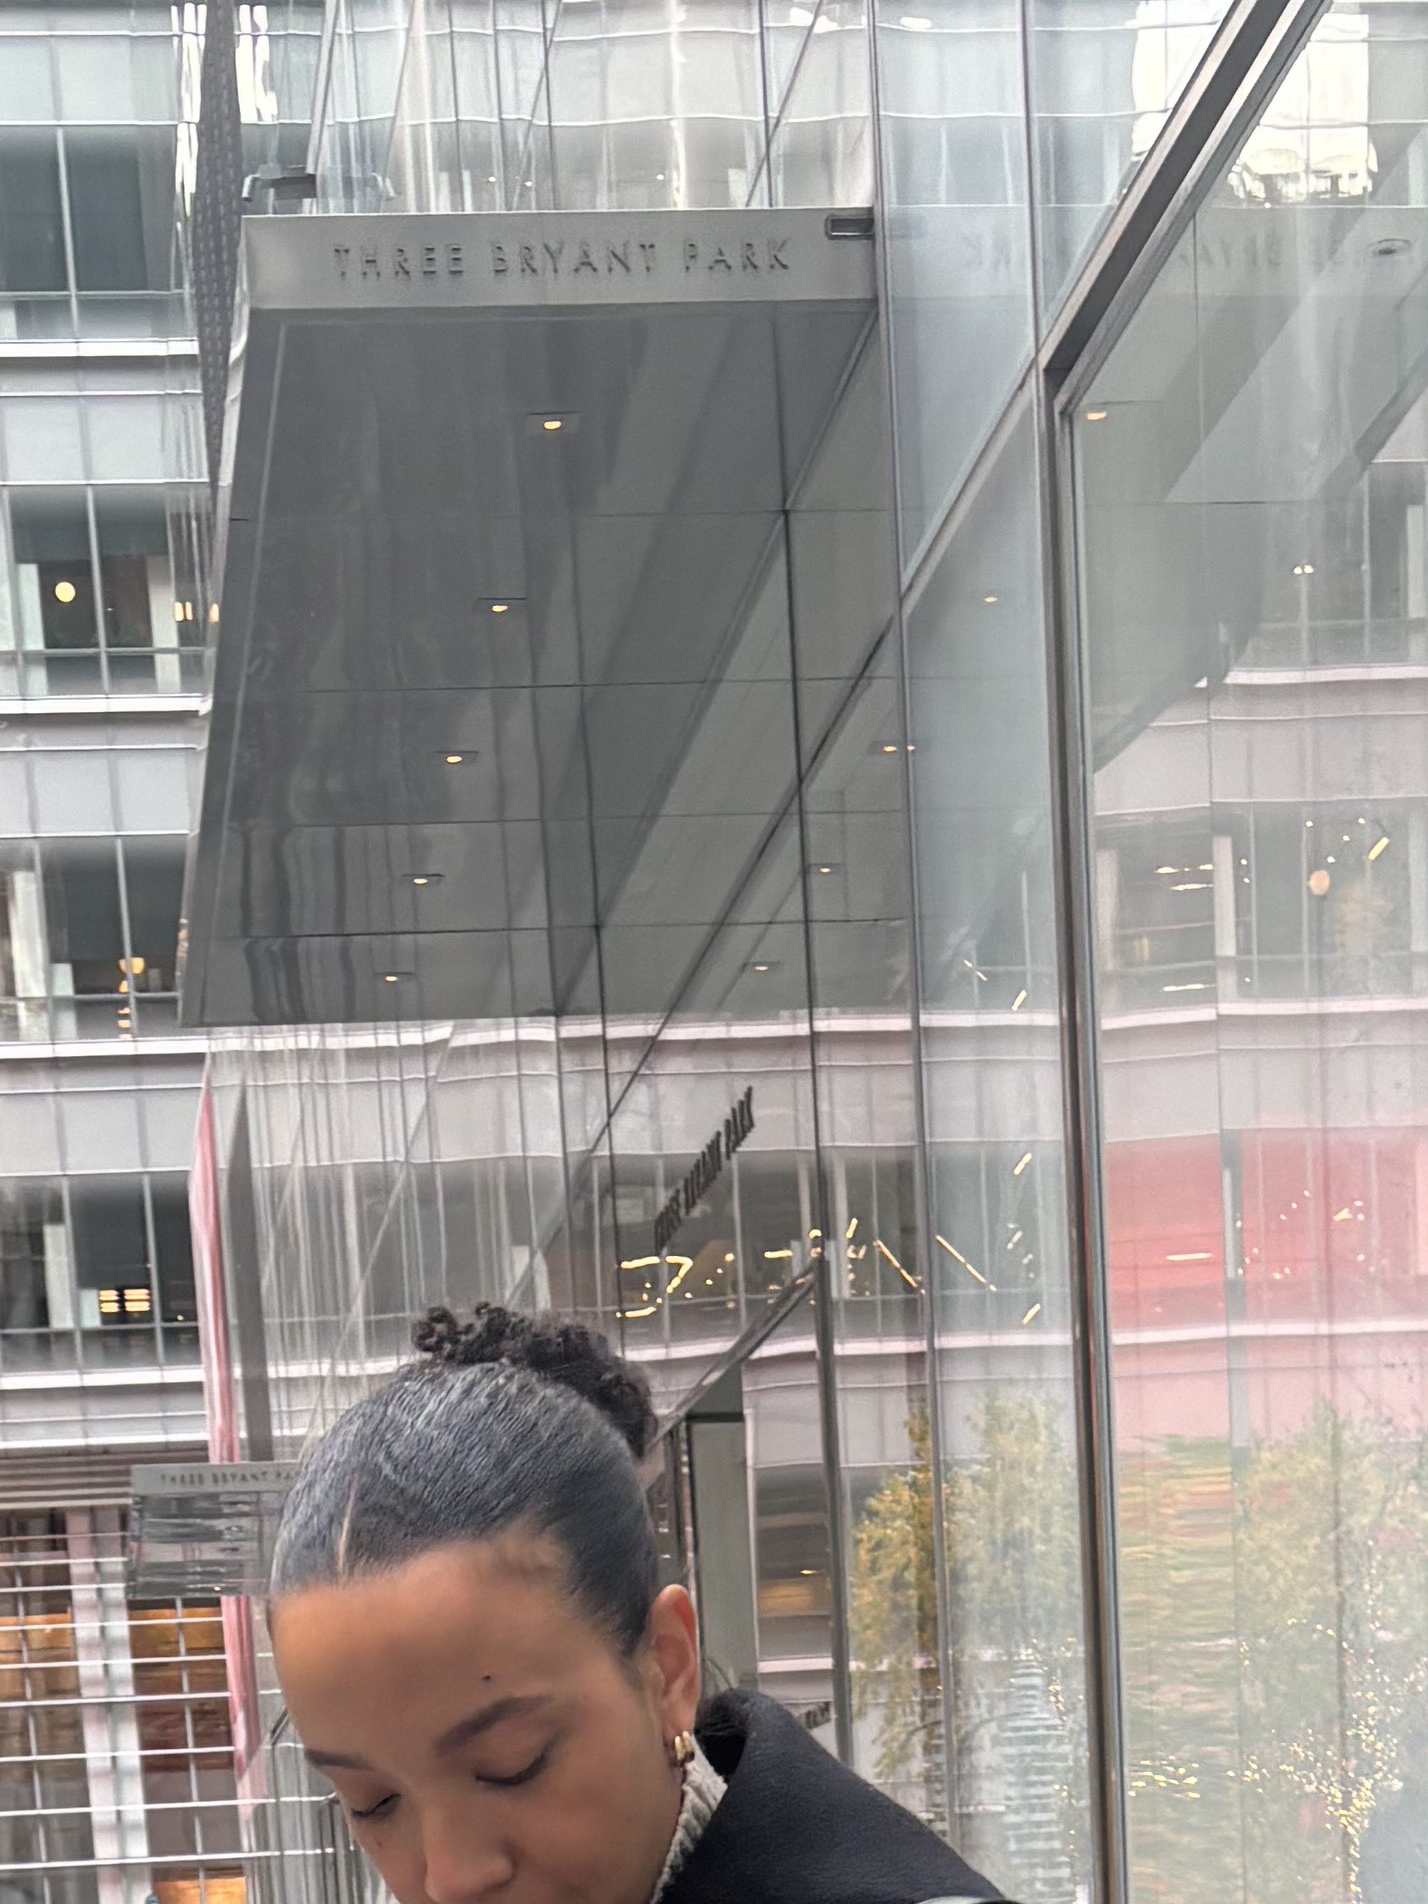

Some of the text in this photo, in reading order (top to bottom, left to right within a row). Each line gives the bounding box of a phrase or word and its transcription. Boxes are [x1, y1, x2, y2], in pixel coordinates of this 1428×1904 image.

[333, 237, 791, 279] THREE BRYANT PARK
